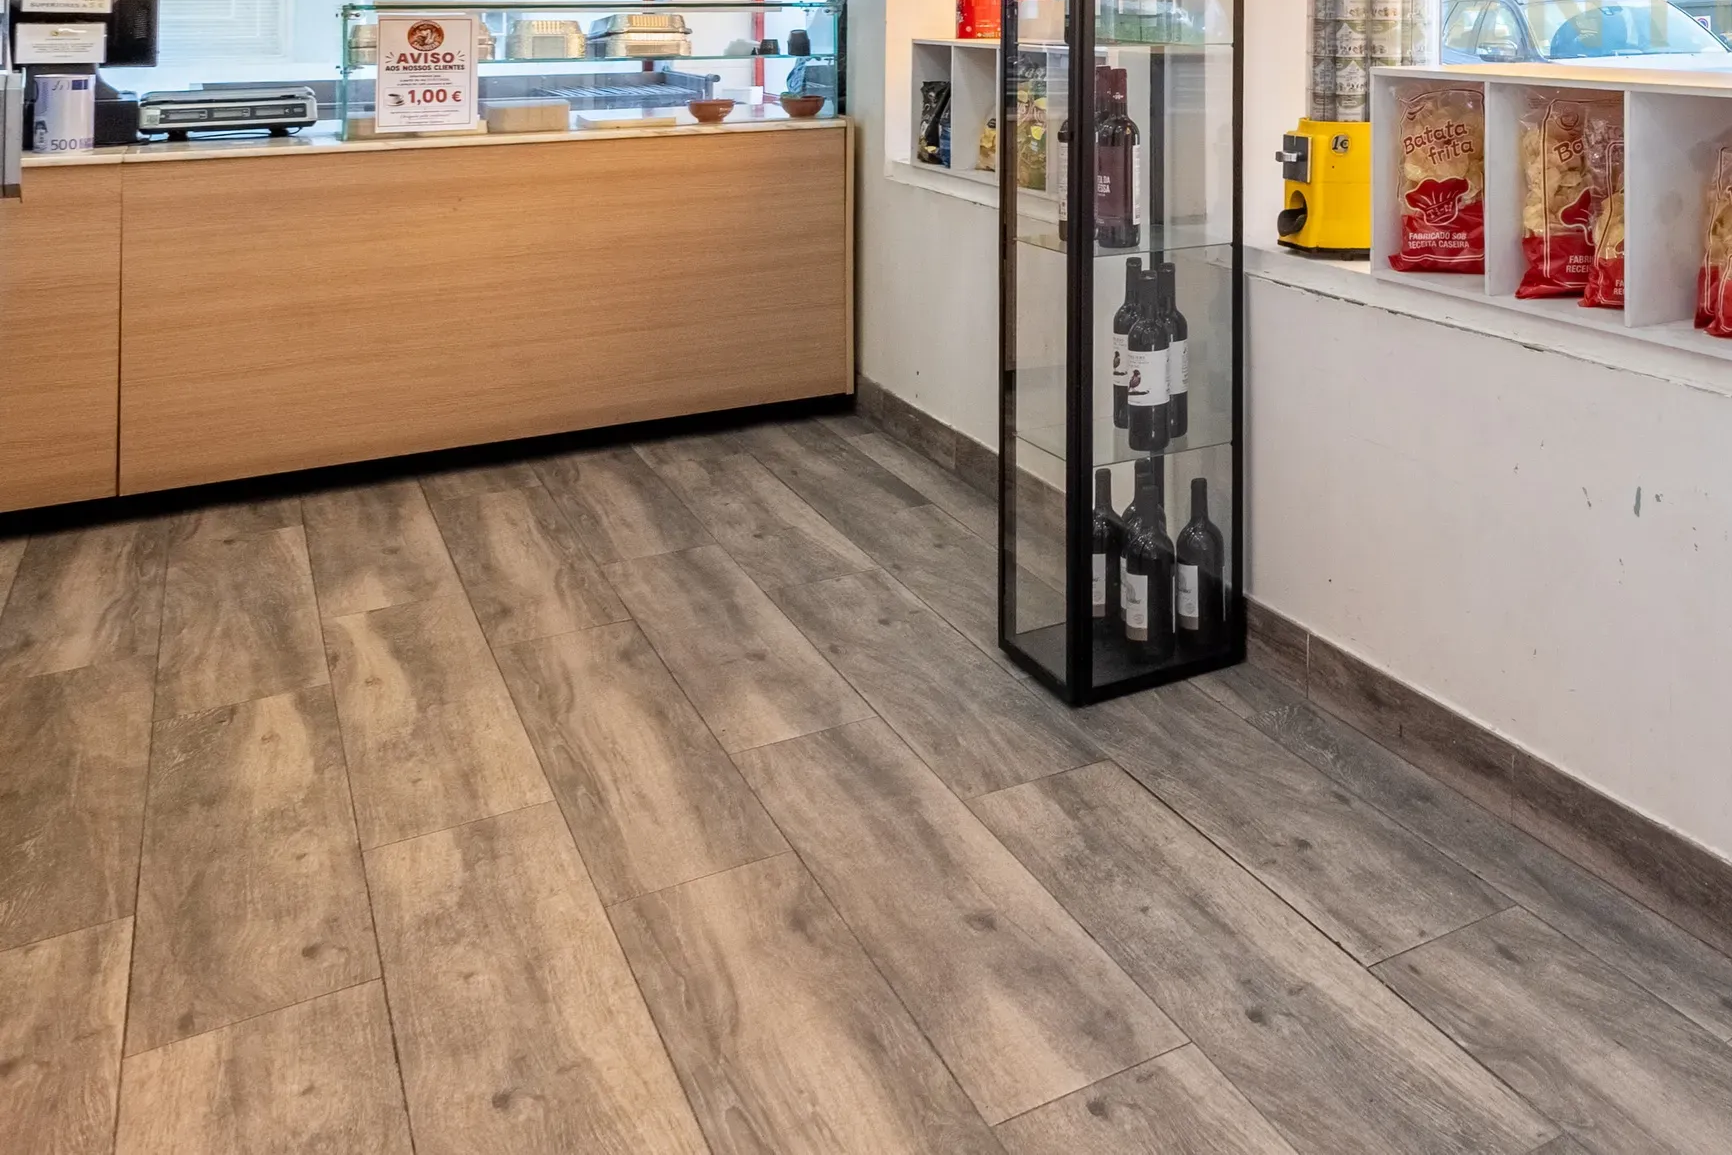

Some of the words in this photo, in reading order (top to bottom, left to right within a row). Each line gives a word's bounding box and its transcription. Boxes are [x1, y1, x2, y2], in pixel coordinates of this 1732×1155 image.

[396, 52, 455, 64] AVISO
[408, 88, 448, 105] 1,00
[452, 90, 462, 102] €
[1403, 120, 1468, 155] Batata
[50, 138, 78, 151] 500
[1428, 139, 1474, 165] frita
[1409, 232, 1451, 240] FABRICADO
[1452, 232, 1467, 240] SOB
[1438, 240, 1469, 248] CASEIRA
